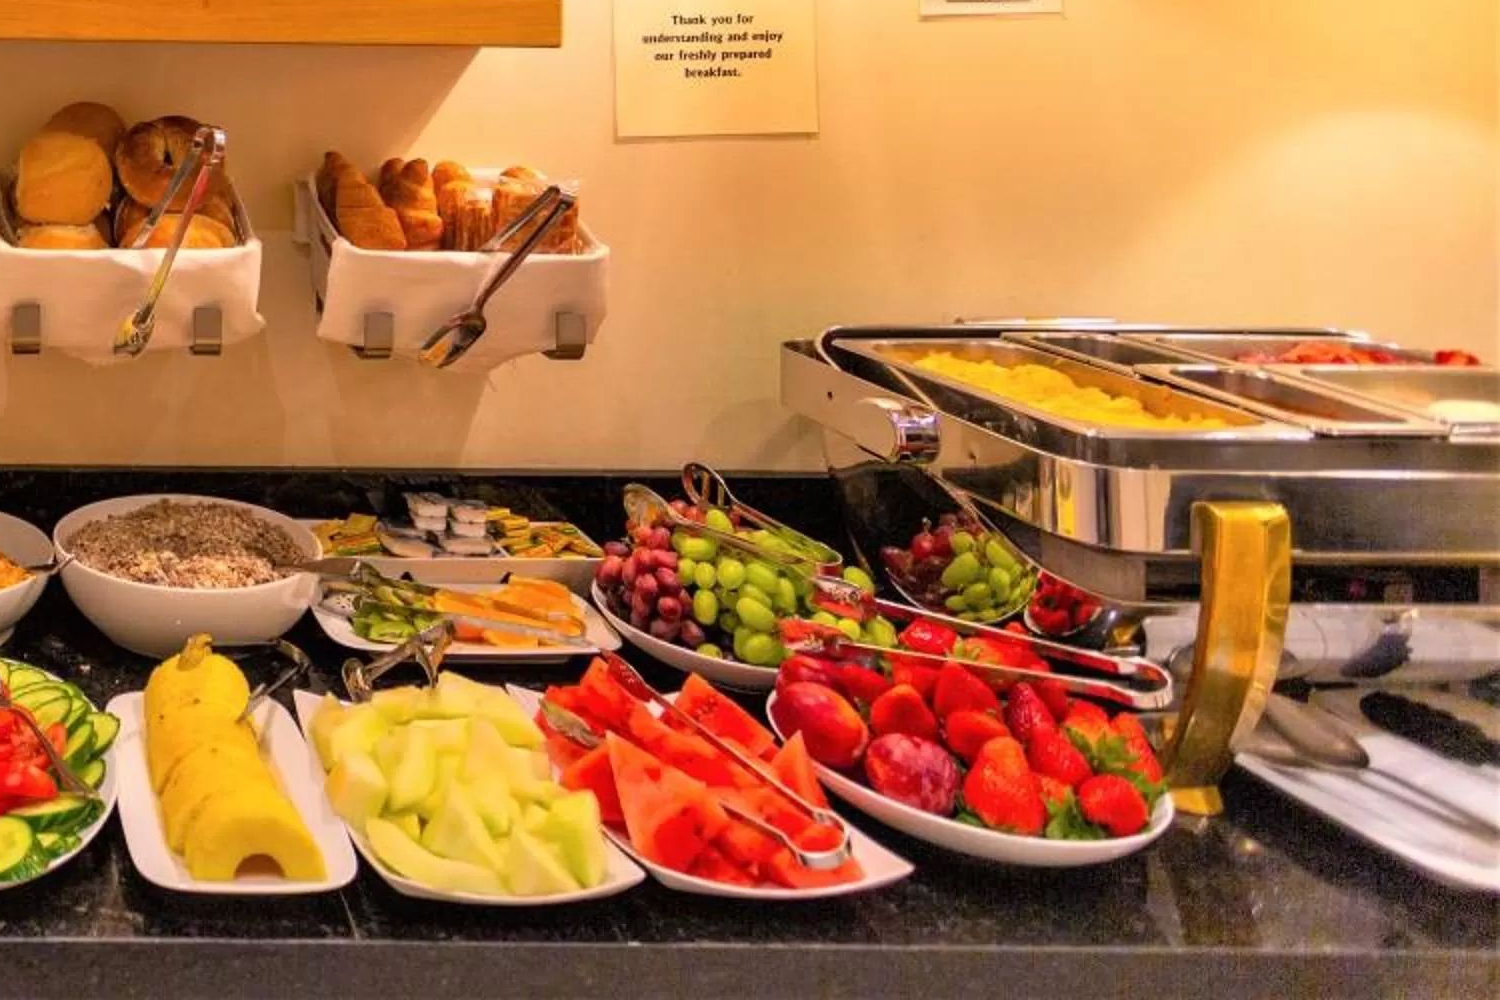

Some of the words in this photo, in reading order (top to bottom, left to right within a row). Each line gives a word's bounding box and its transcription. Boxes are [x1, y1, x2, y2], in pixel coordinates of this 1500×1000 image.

[671, 14, 706, 25] Thank
[710, 15, 733, 26] you
[736, 13, 754, 24] for
[641, 31, 723, 44] understanding
[727, 31, 748, 42] and
[751, 30, 784, 43] enjoy
[654, 51, 675, 61] our
[678, 49, 717, 62] freshly
[720, 48, 772, 62] prepared
[684, 67, 741, 79] breakfast.
